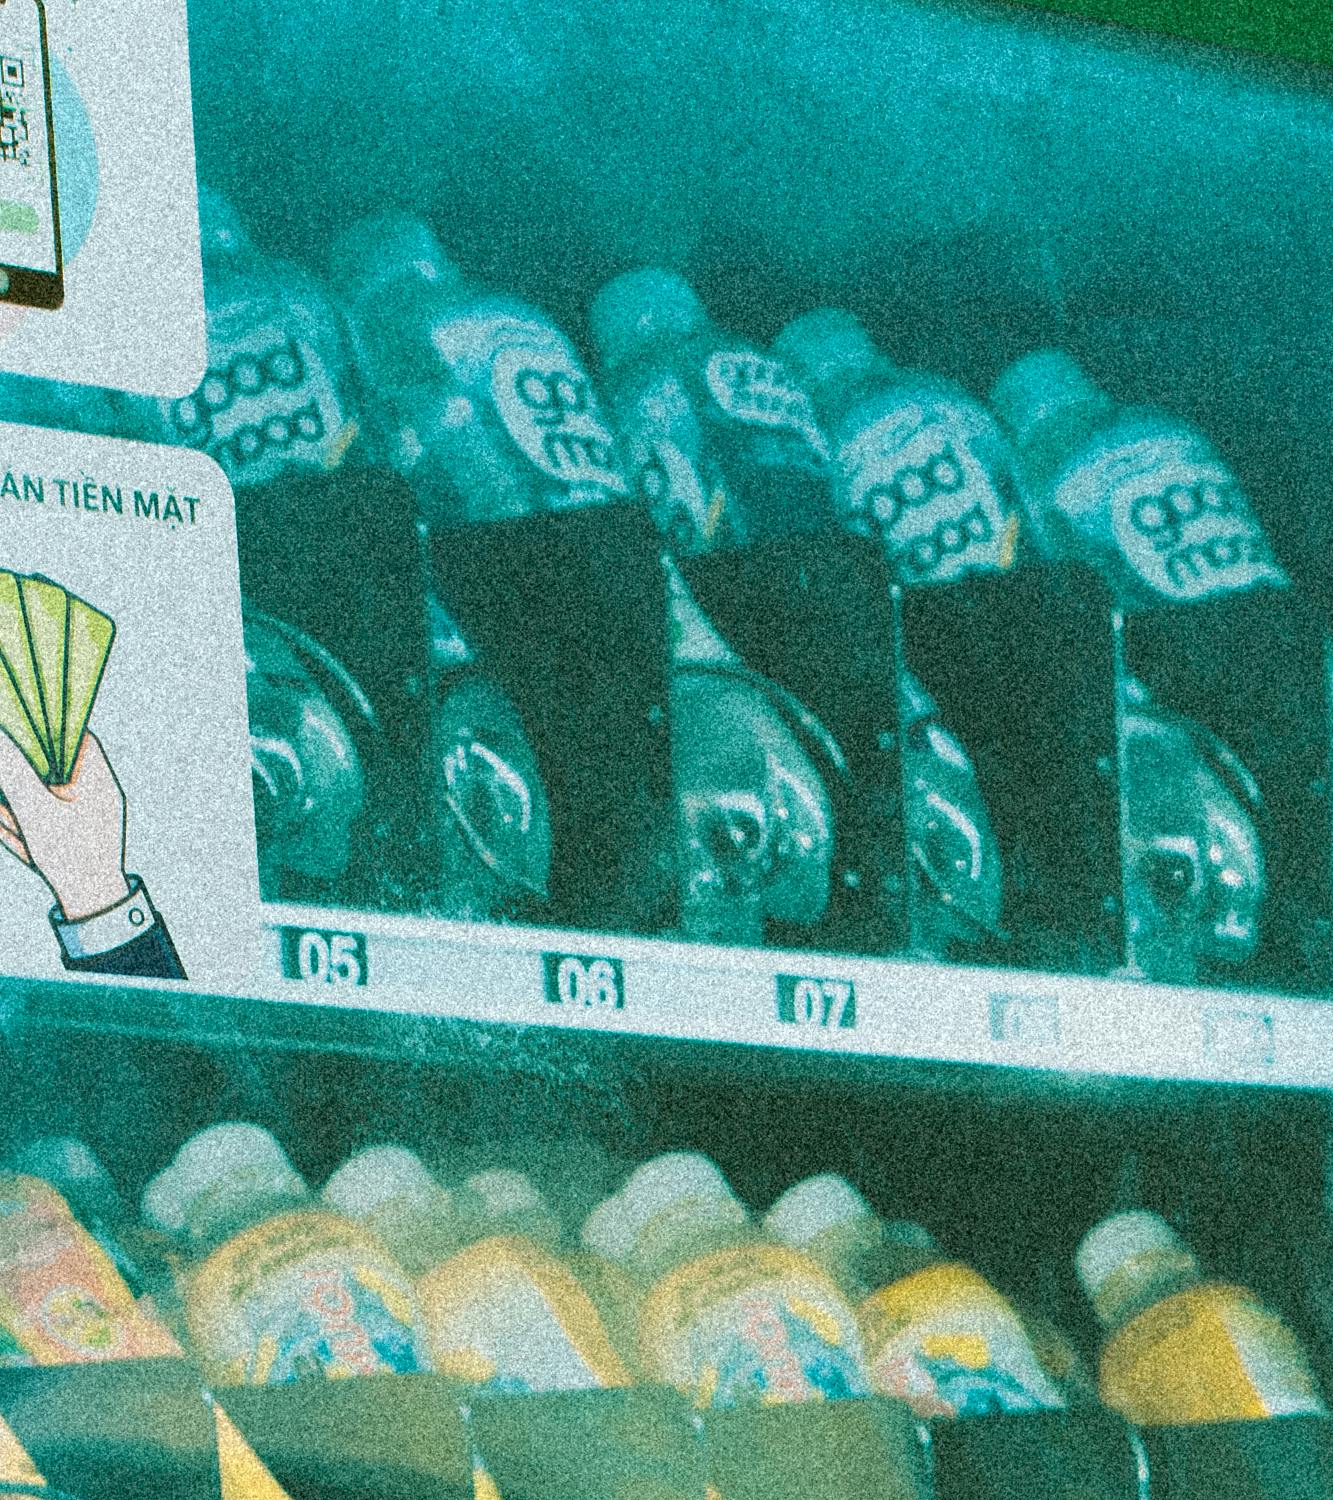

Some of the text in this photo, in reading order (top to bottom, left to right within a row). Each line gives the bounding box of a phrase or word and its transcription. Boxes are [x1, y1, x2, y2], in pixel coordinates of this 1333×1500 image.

[53, 469, 123, 515] TIỀN
[133, 486, 200, 531] MẶT
[297, 930, 362, 984] 05
[557, 957, 618, 1010] 06
[792, 979, 853, 1032] 07
